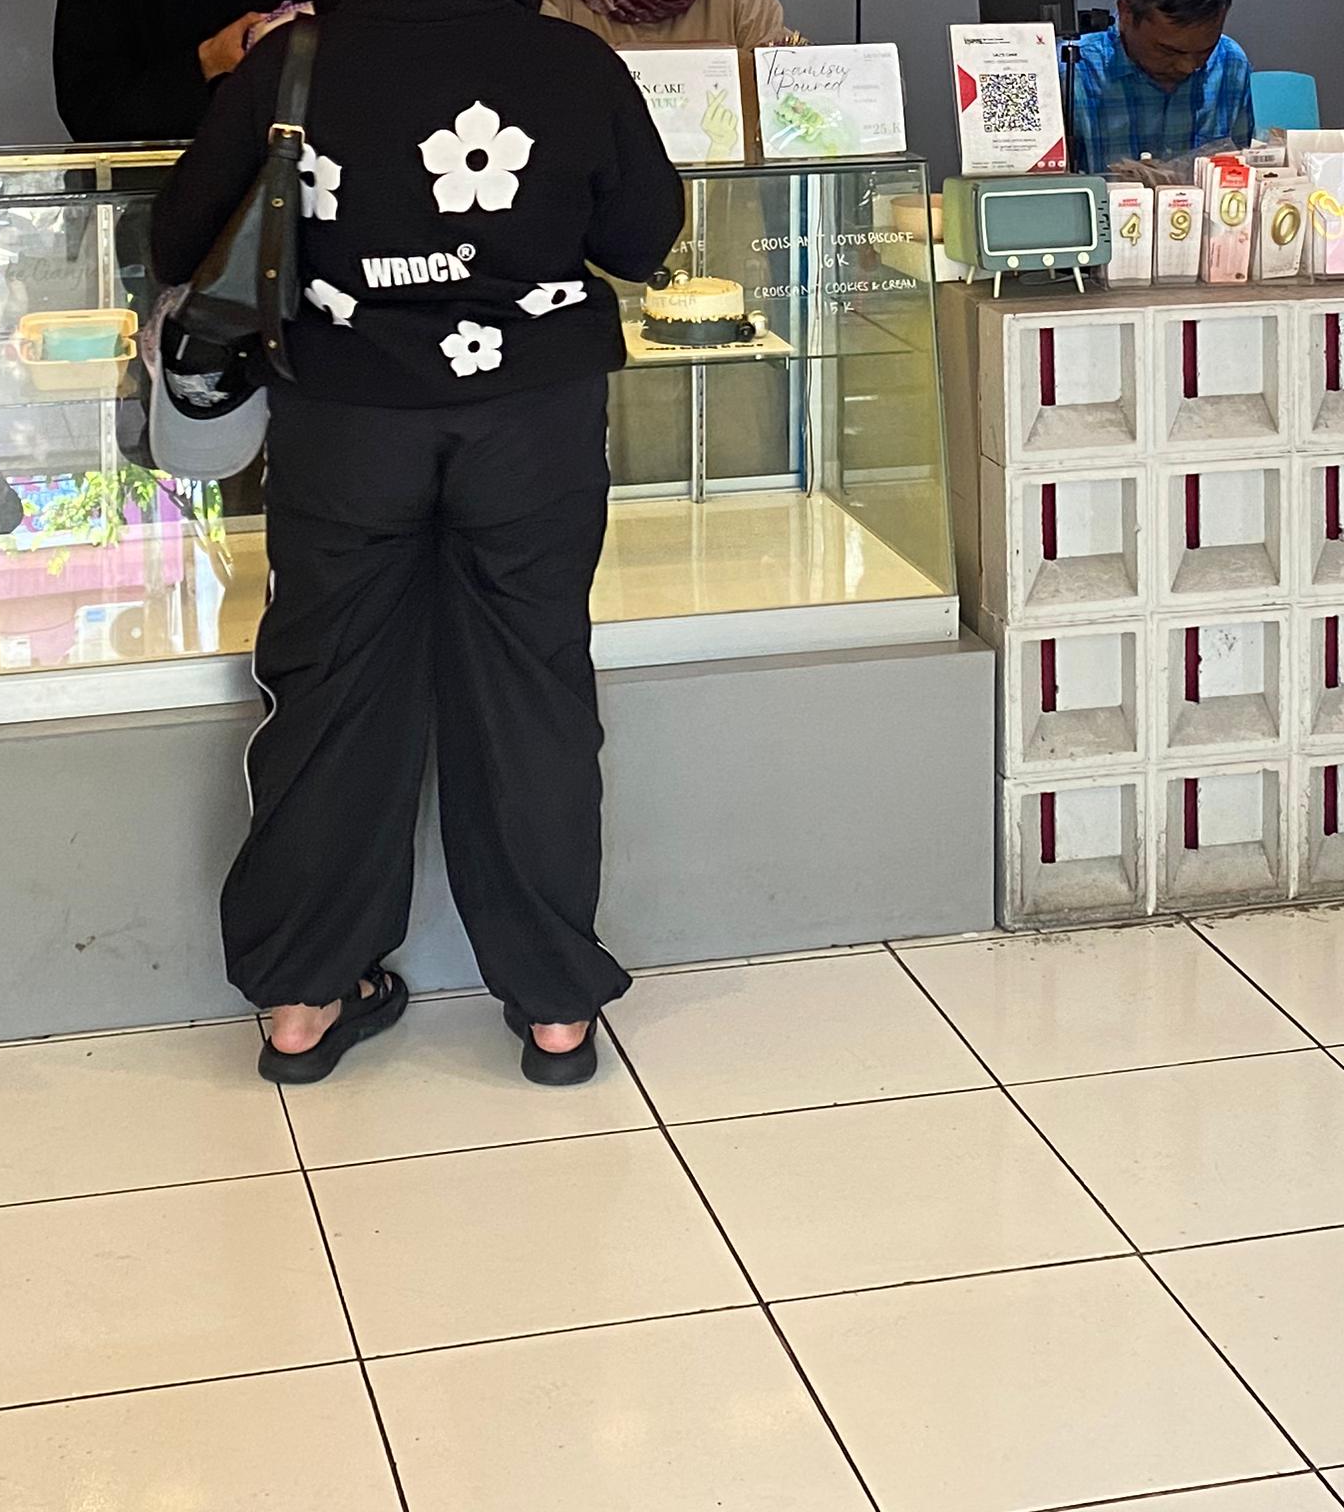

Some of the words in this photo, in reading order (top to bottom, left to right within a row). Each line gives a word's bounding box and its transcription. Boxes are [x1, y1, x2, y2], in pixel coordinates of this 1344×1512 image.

[653, 84, 685, 94] CAKE
[1120, 213, 1141, 246] 4
[1169, 209, 1192, 241] 9
[831, 233, 867, 246] LOTUS
[868, 231, 914, 245] BISCOFF
[825, 281, 868, 294] COOKIES
[881, 279, 917, 290] CREAM
